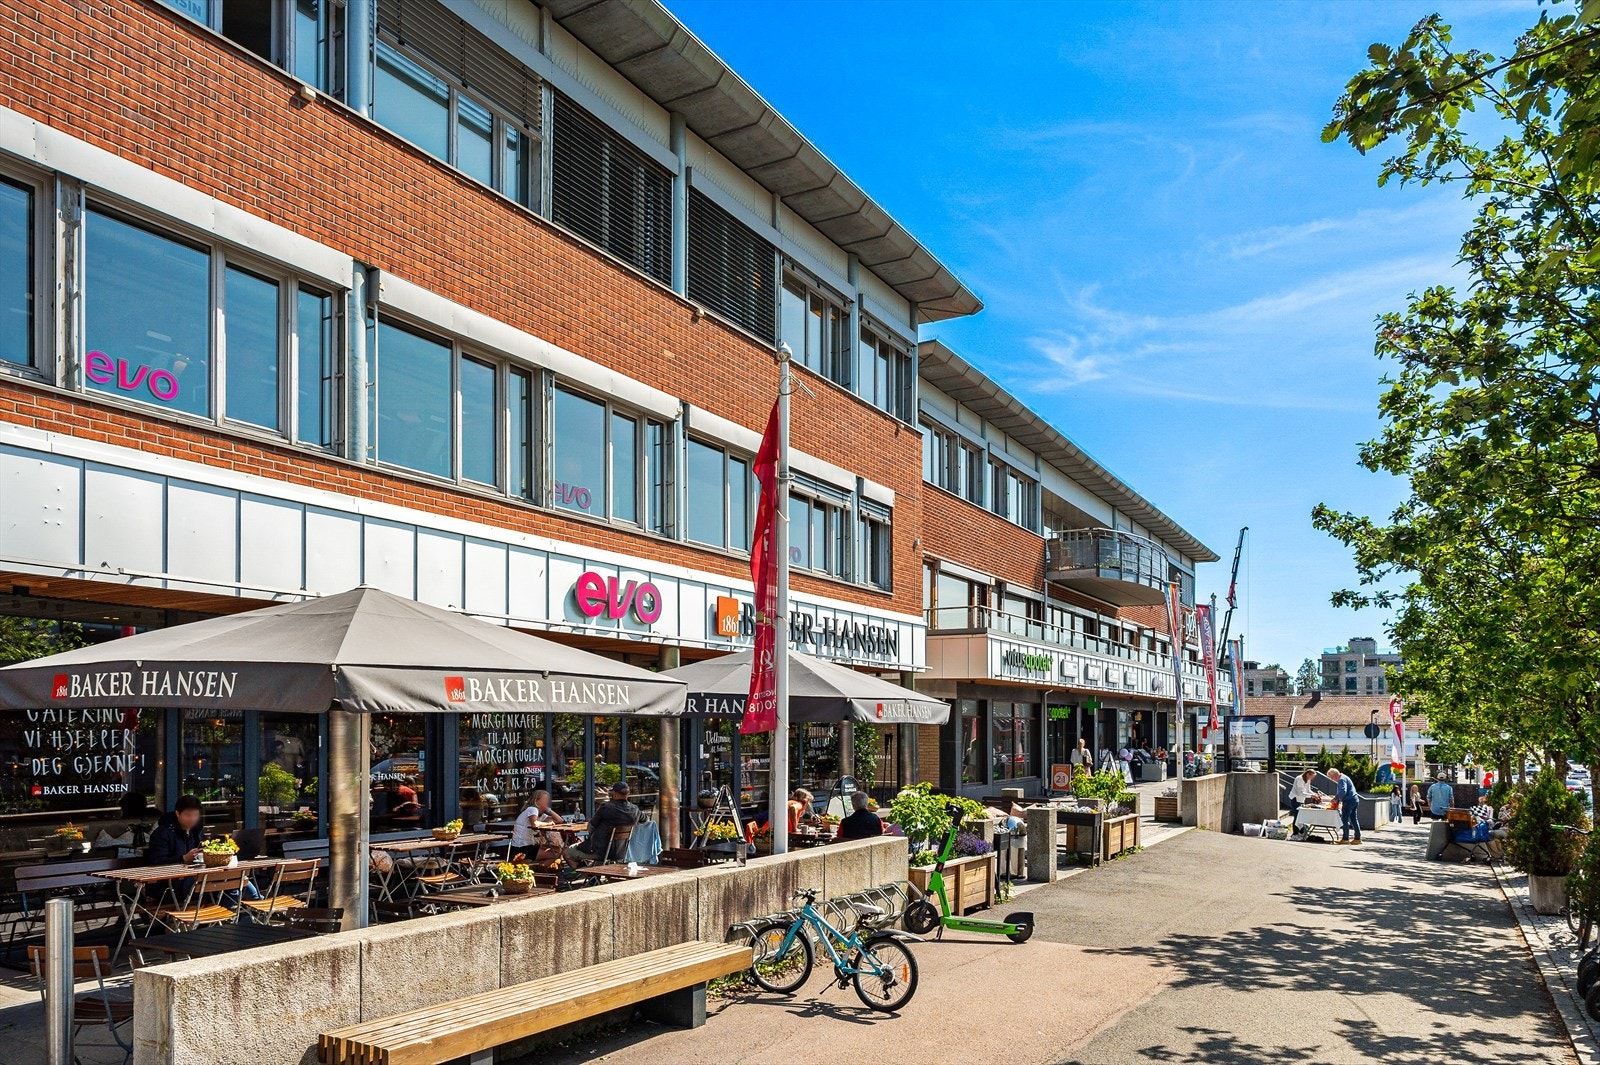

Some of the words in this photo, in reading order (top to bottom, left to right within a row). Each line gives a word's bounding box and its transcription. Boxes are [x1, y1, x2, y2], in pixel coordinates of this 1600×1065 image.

[86, 350, 180, 402] evo
[575, 571, 662, 624] evo
[742, 602, 816, 645] BER
[823, 617, 898, 658] HANSEN
[70, 672, 135, 698] BAKER
[140, 671, 238, 698] HANSEN
[468, 678, 544, 703] BAKER
[550, 680, 630, 706] HANSEN
[704, 698, 746, 714] HAN
[883, 703, 906, 718] BAKER
[907, 704, 932, 719] HANSEN
[472, 713, 541, 729] MORGENKAFFE
[51, 728, 135, 752] HJELPER
[501, 731, 522, 745] ALLE
[32, 757, 62, 776] DEG
[501, 768, 519, 776] BAKER
[377, 772, 406, 781] HANSEN
[477, 777, 489, 792] KR
[511, 777, 520, 791] KL
[43, 785, 80, 795] BAKER
[83, 783, 128, 794] HANSEN
